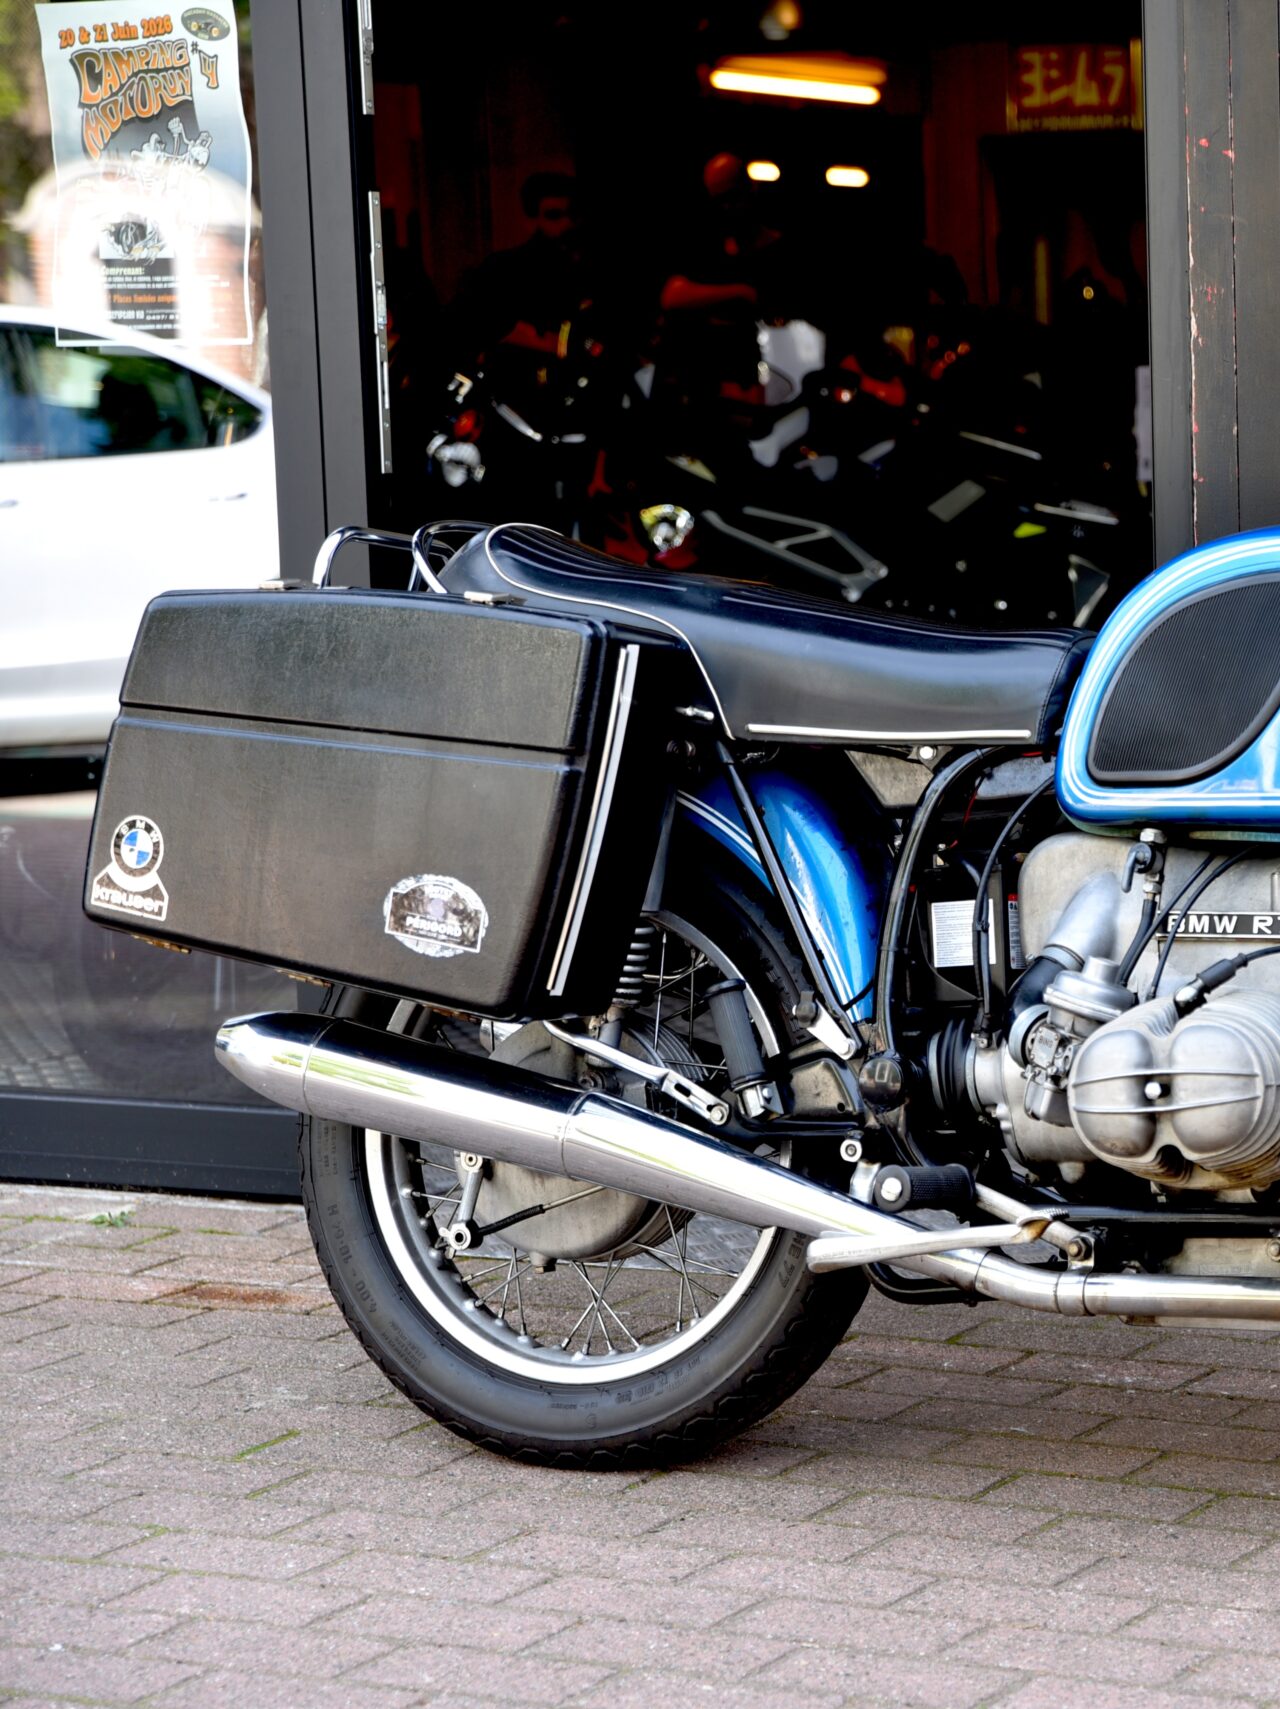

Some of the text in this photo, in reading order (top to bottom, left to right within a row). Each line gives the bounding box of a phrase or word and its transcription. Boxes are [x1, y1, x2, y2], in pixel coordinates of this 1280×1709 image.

[59, 28, 75, 49] 20
[79, 27, 91, 44] &
[93, 23, 109, 42] 21
[111, 20, 139, 42] Juin
[141, 14, 173, 39] 2026
[1021, 50, 1125, 108] ヨシムラ
[82, 66, 193, 163] MOTORUN
[120, 819, 160, 843] BMW
[1167, 914, 1238, 934] BMW
